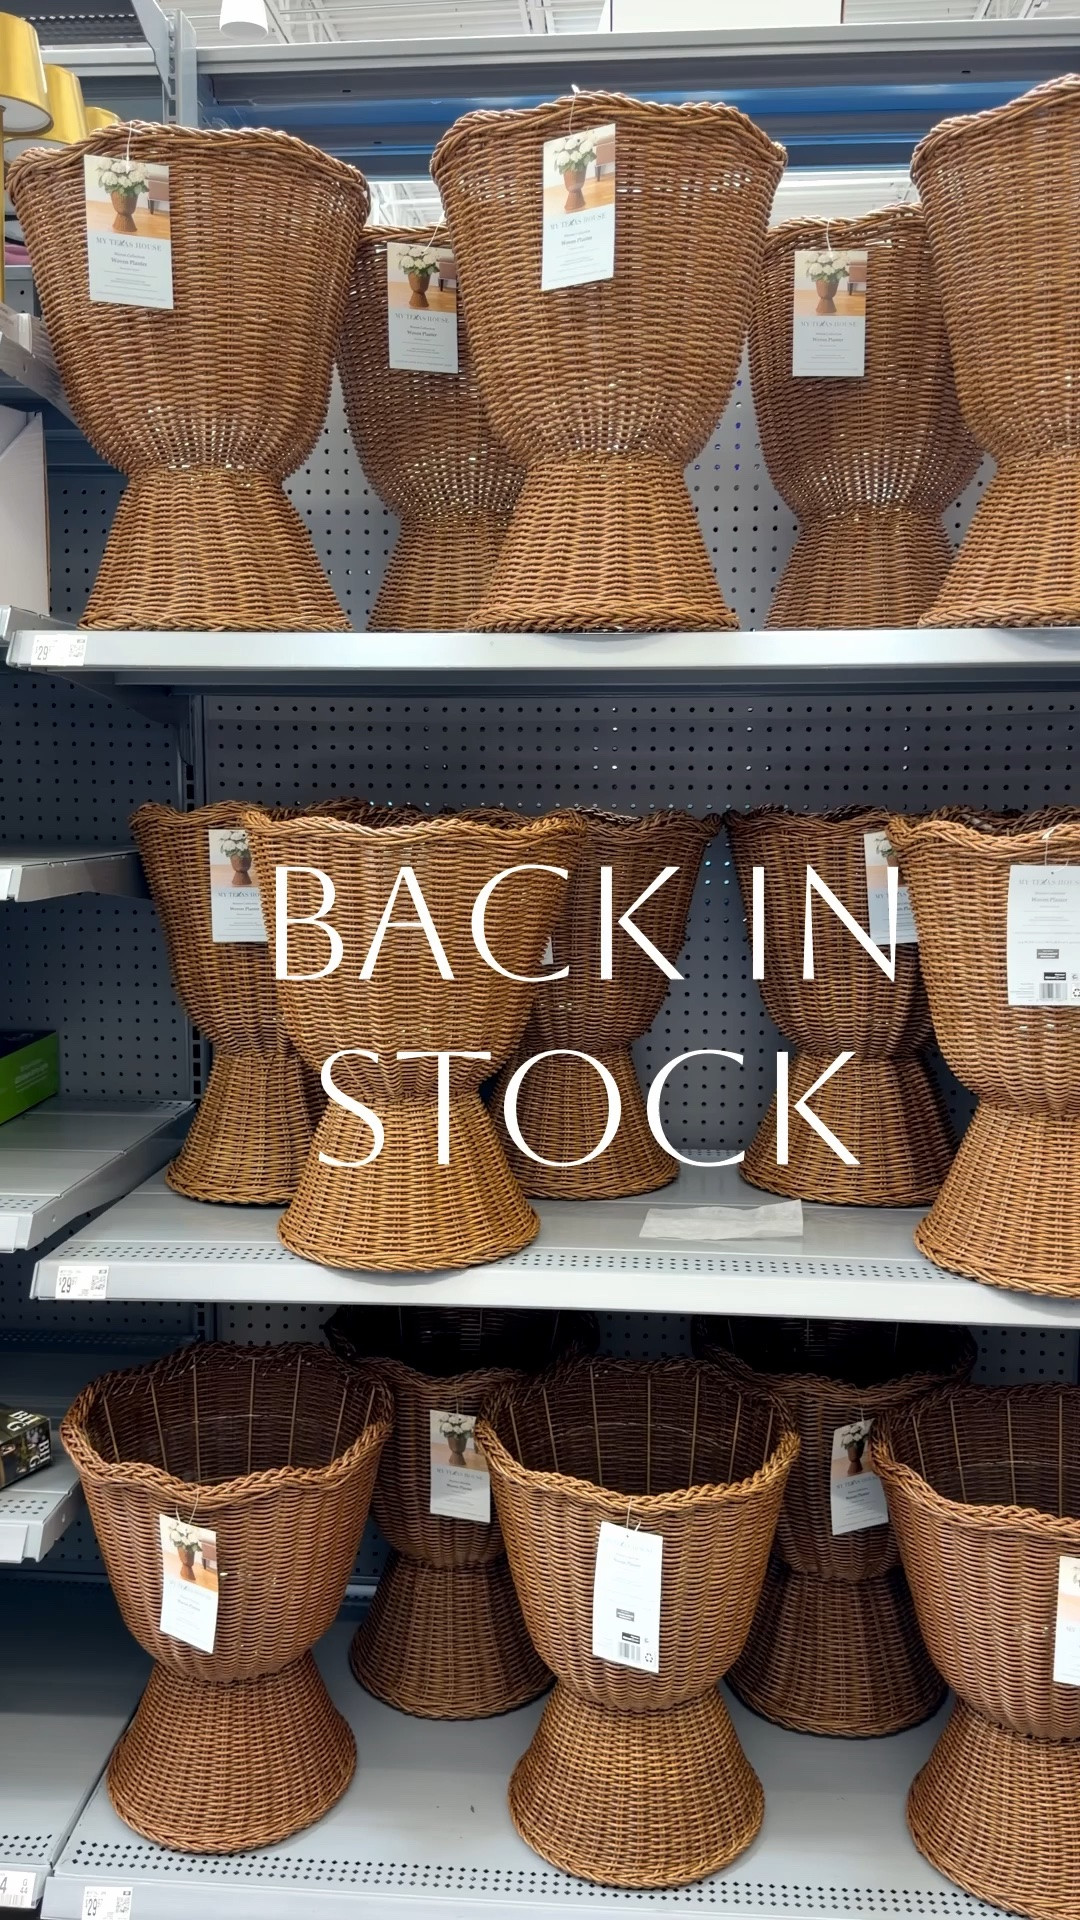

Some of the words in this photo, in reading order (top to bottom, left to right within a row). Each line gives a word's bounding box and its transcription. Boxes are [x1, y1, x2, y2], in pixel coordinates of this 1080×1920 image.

[96, 236, 107, 245] MY
[108, 238, 134, 248] TEXAS
[135, 242, 162, 252] HOUSE
[111, 257, 129, 265] Woven
[129, 259, 148, 267] Planter
